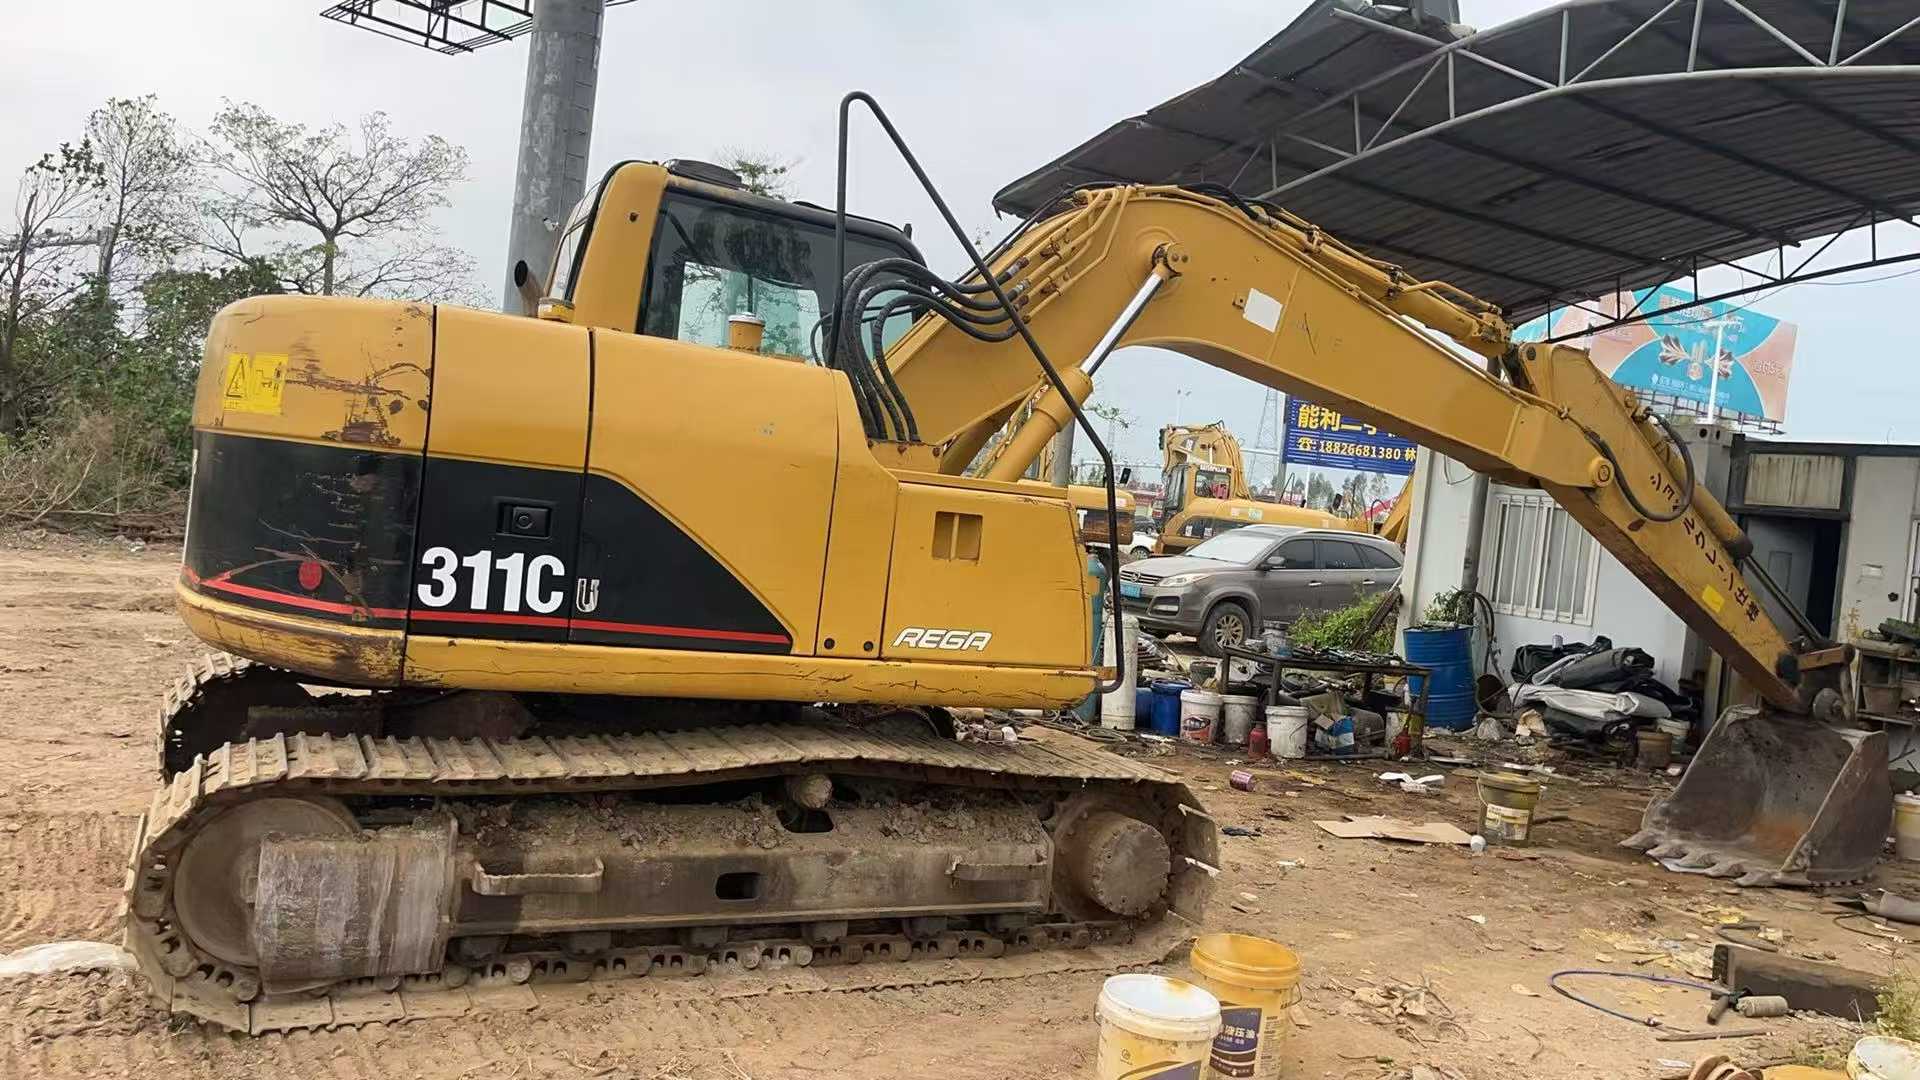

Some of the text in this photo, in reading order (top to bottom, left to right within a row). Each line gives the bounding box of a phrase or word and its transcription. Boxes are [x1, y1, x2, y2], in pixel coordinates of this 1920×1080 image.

[417, 546, 600, 613] 311C U
[892, 627, 993, 651] REGA
